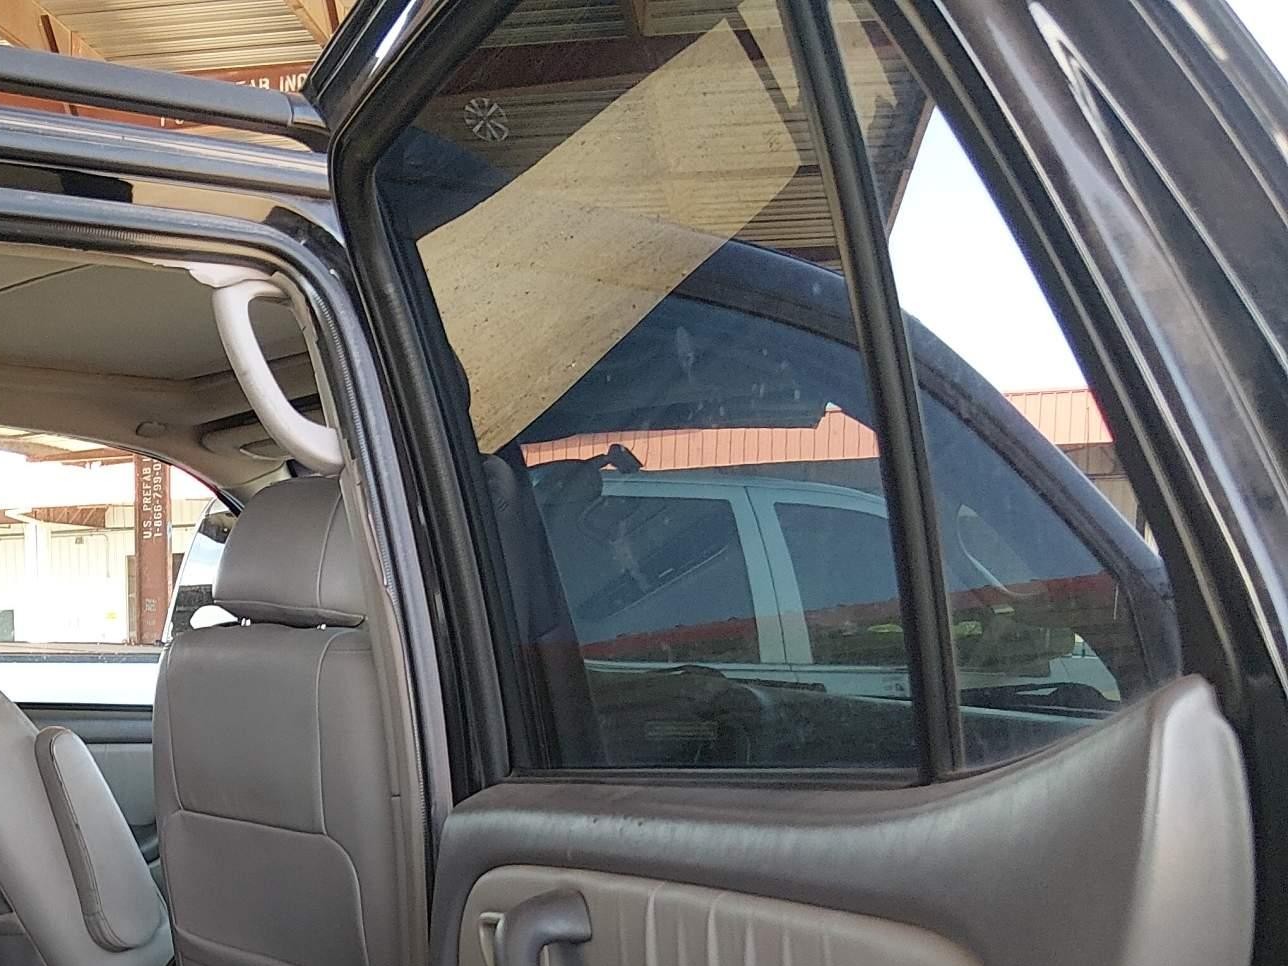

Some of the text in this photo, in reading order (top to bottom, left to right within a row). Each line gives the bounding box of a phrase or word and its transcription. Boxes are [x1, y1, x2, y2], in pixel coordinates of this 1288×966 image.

[143, 467, 152, 512] PREFAB
[153, 459, 162, 538] 1-866-799-0
[143, 517, 153, 539] U.S.
